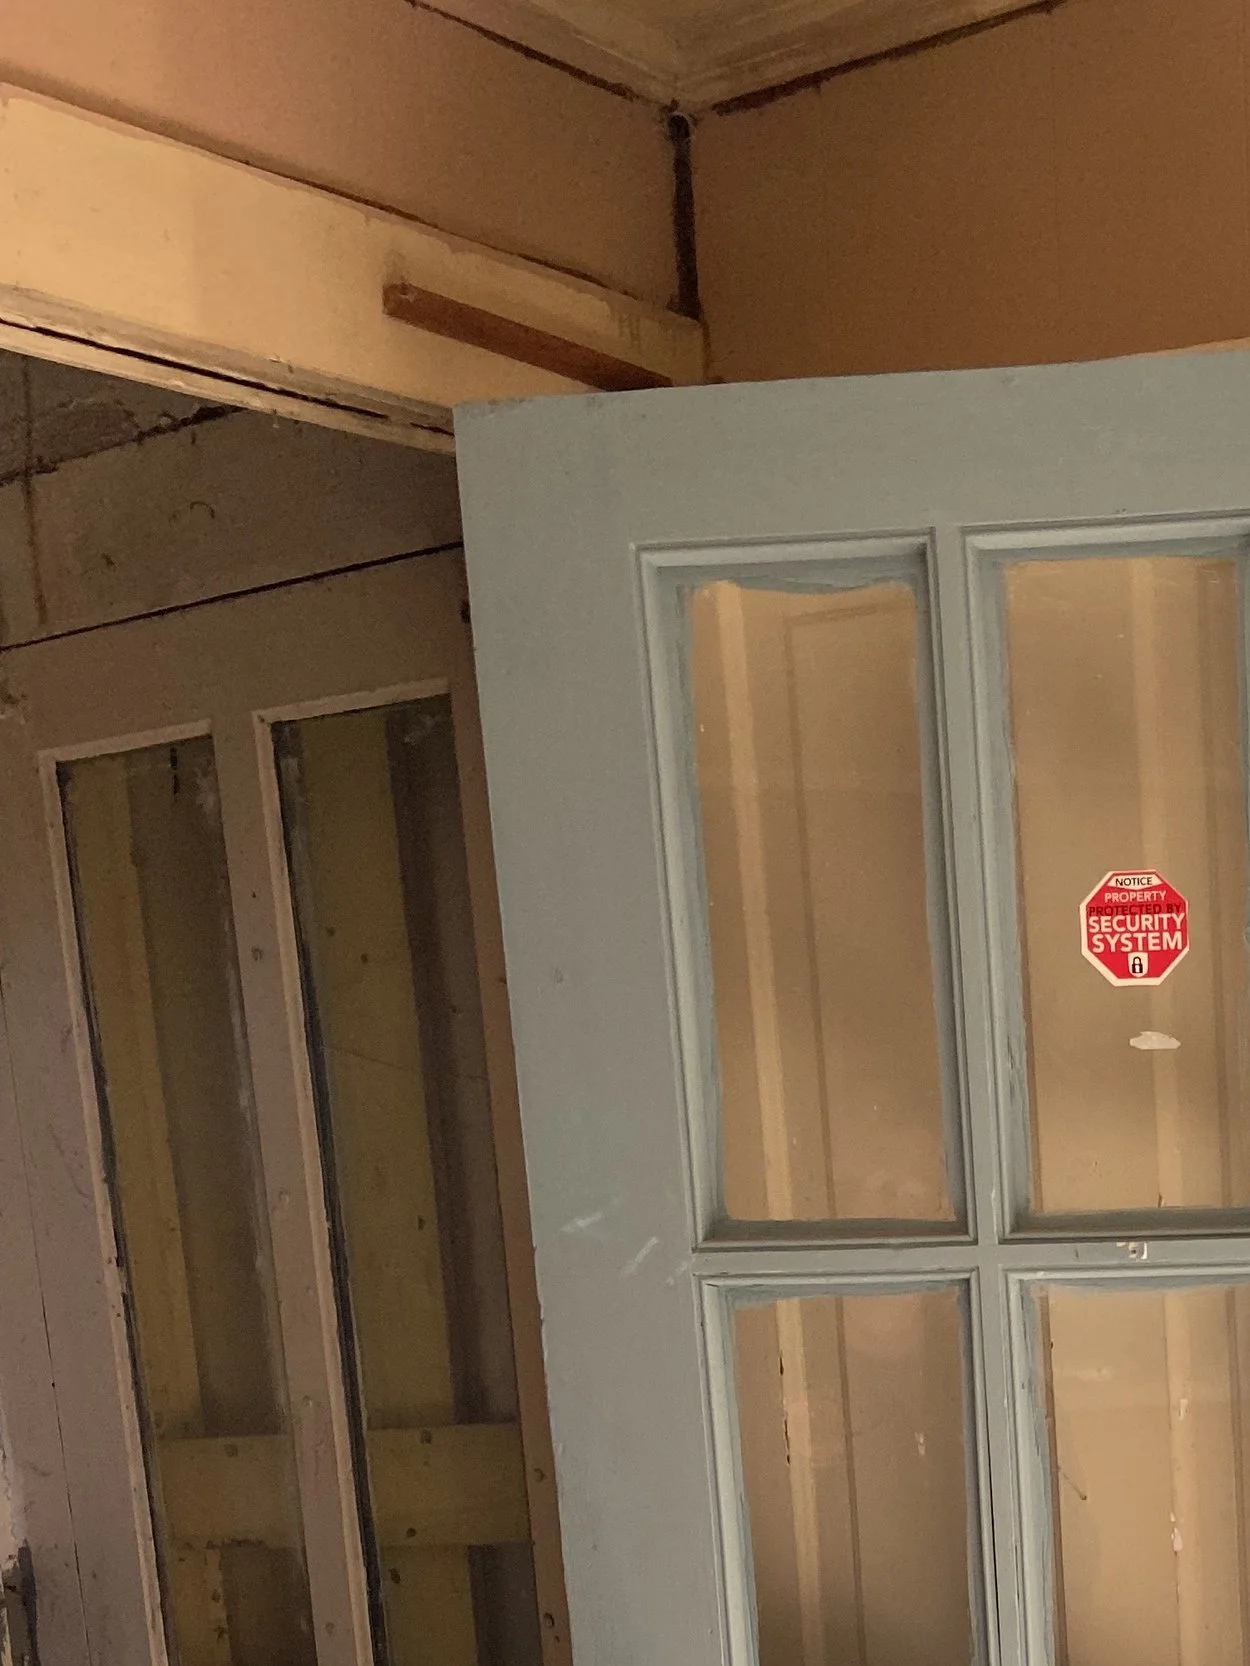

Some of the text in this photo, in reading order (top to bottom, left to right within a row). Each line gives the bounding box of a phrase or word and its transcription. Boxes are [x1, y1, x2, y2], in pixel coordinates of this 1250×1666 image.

[1115, 877, 1153, 886] NOTICE
[1104, 890, 1167, 903] PROPERTY
[1089, 904, 1181, 916] PROTECTED BY
[1089, 912, 1185, 933] SECURITY
[1092, 931, 1182, 953] SYSTEM
